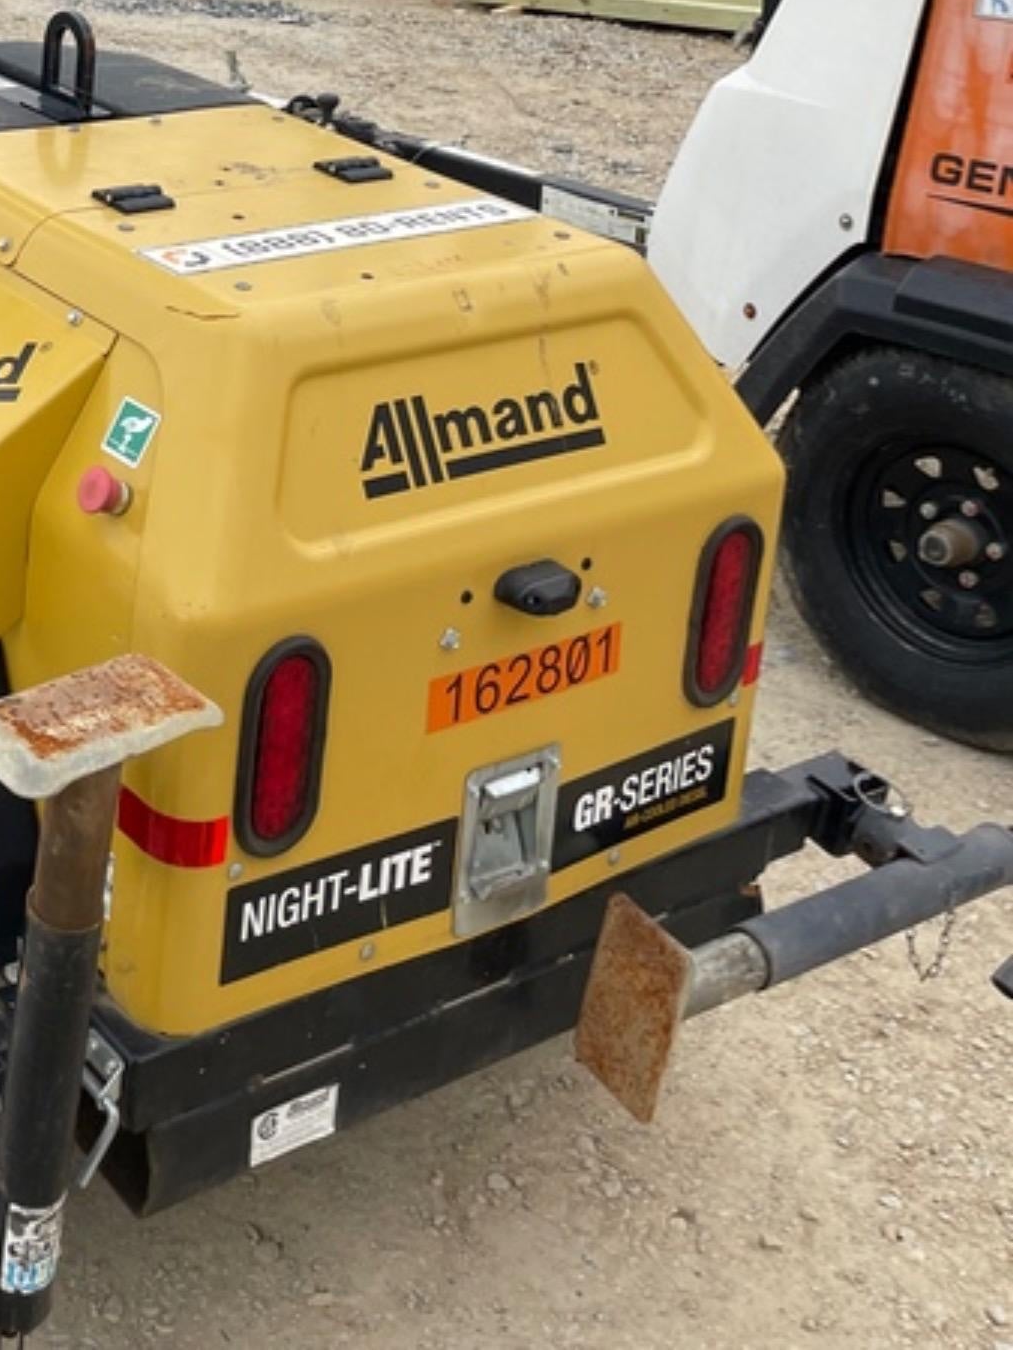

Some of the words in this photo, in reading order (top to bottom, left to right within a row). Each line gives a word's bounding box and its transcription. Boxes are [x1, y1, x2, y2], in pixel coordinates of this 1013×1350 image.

[360, 362, 600, 488] Allmand
[445, 626, 613, 724] 162801
[574, 743, 716, 833] GR-SERIES
[239, 841, 435, 944] NIGHT-LITE
